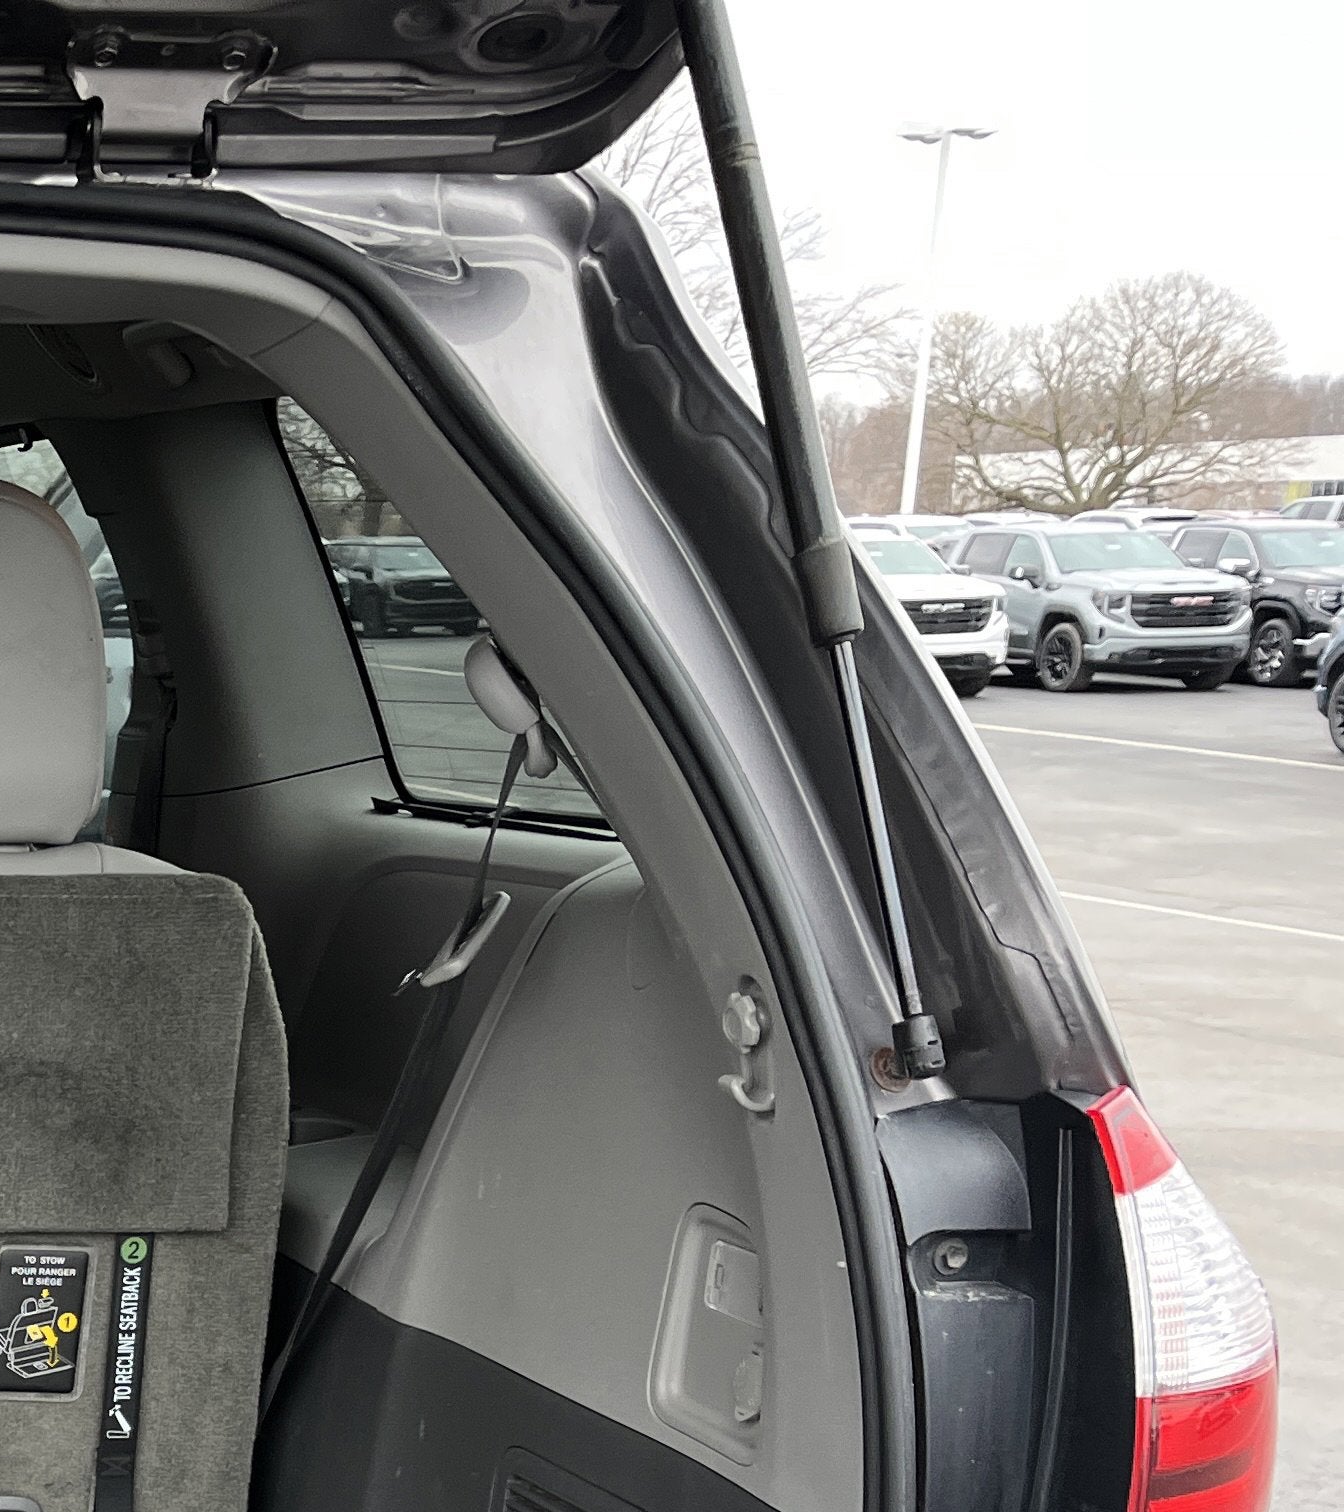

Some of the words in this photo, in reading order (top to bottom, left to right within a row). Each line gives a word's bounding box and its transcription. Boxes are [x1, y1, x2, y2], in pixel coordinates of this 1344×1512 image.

[127, 1241, 140, 1260] 2
[24, 1256, 37, 1264] TO
[40, 1256, 66, 1265] STOW
[11, 1267, 37, 1276] POUR
[38, 1267, 76, 1276] RANGER
[23, 1277, 34, 1286] LE
[118, 1267, 142, 1331] SEATBACK
[115, 1332, 136, 1385] RECLINE
[114, 1385, 132, 1403] TO
